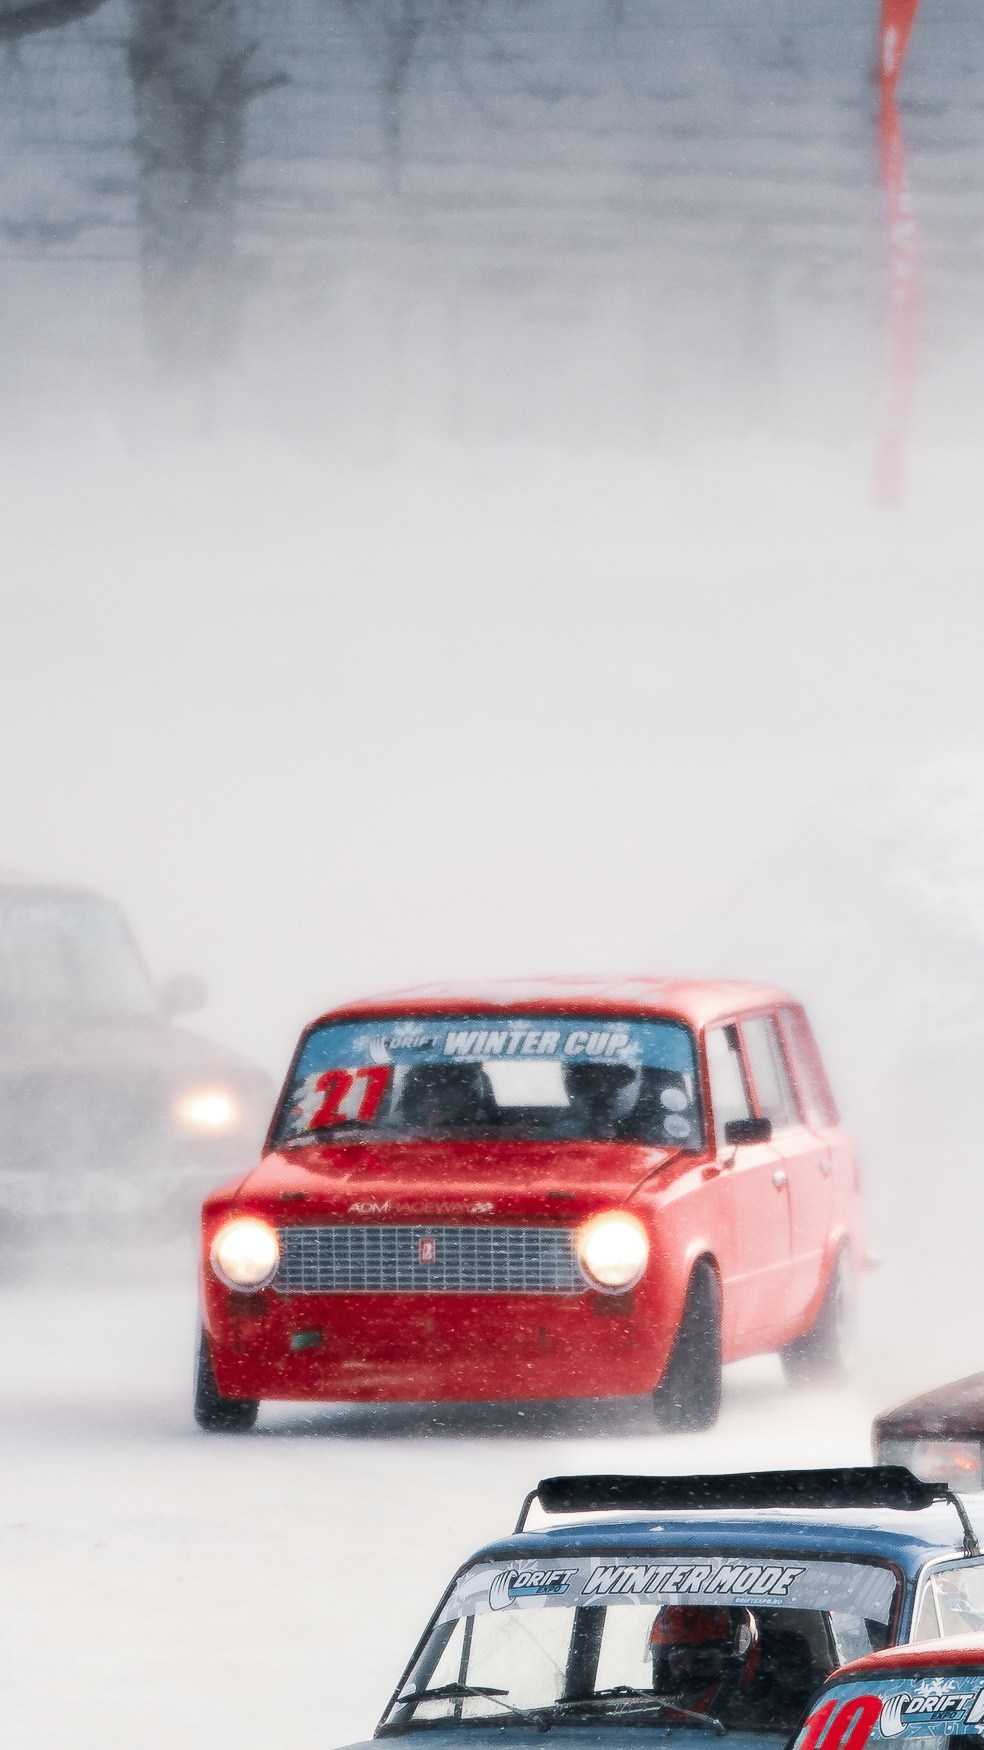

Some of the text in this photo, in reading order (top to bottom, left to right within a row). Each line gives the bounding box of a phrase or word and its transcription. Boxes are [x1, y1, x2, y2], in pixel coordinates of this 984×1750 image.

[443, 1030, 562, 1056] WINTER
[563, 1030, 631, 1057] CUP
[309, 1064, 392, 1129] 27
[512, 1564, 806, 1595] DRIFT WINTER MODE
[536, 1585, 561, 1594] EXPO
[904, 1692, 976, 1714] DRIFT
[930, 1711, 958, 1720] EXPO
